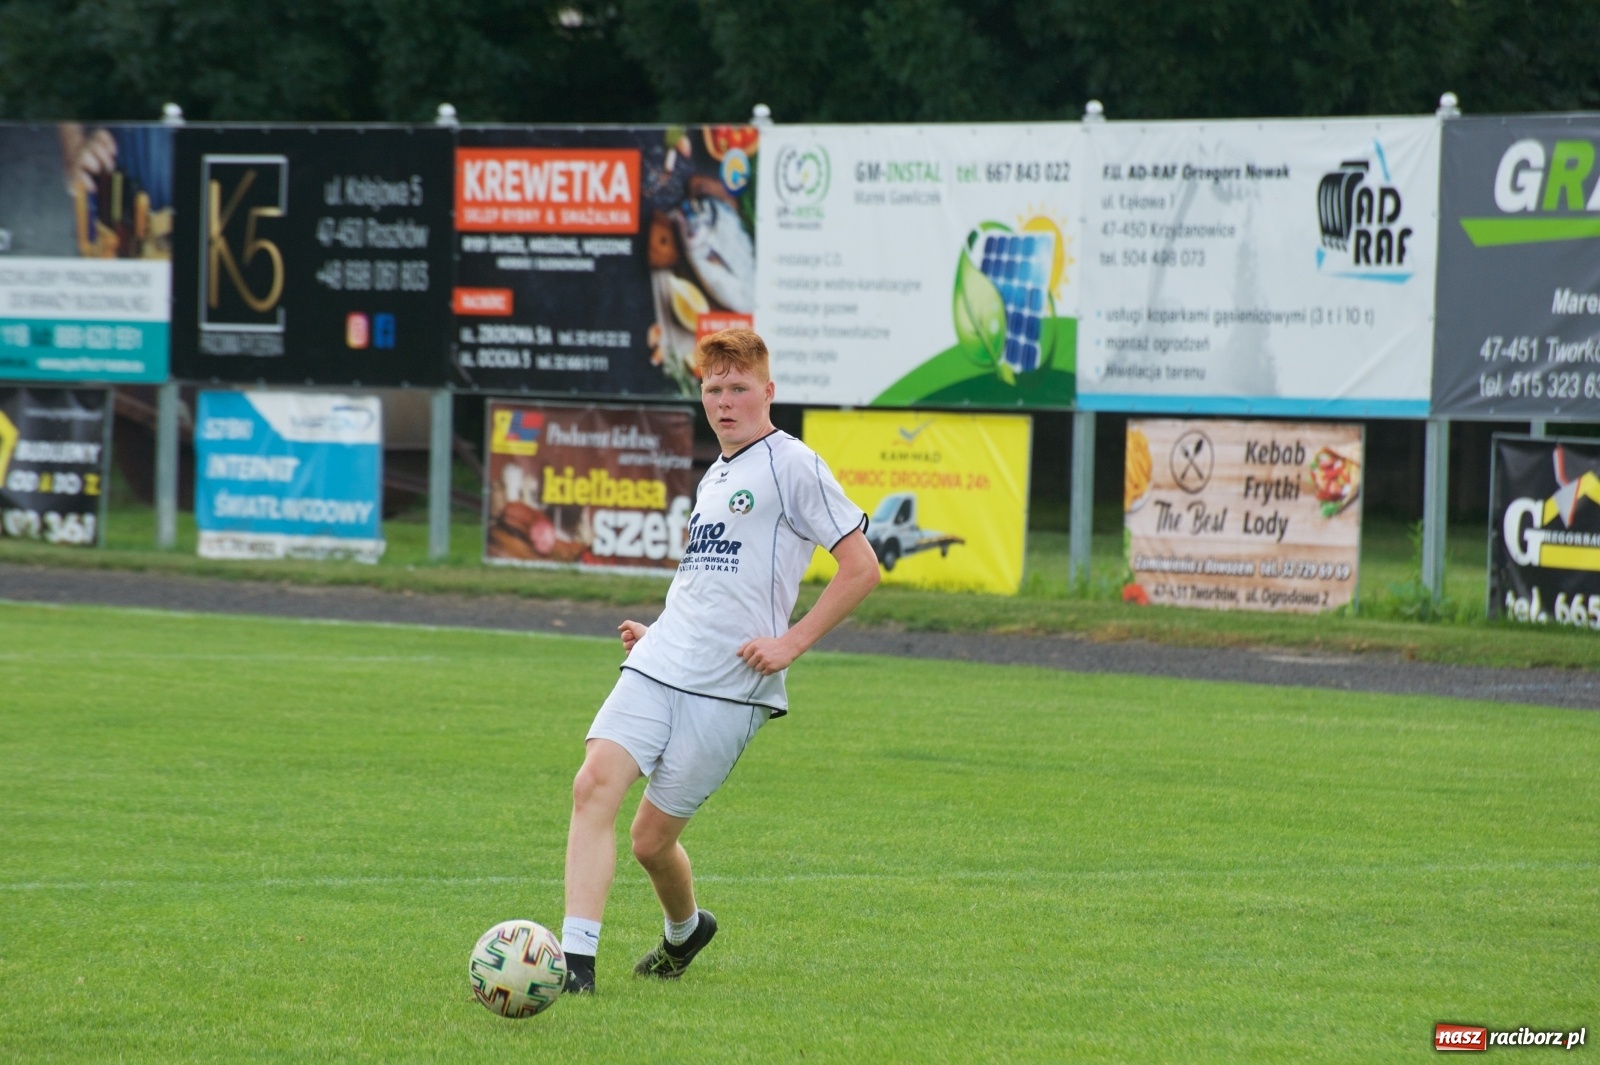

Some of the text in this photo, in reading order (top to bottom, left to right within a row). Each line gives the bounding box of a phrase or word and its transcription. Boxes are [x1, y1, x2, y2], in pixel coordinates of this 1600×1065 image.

[463, 160, 632, 204] KREWETKA
[855, 160, 1070, 183] GM-INSTAL tel. 667 843 022
[1128, 165, 1177, 180] AD-RAF
[1182, 164, 1241, 185] Grzegorz
[1245, 163, 1290, 180] Nowak
[410, 175, 423, 206] 5
[1356, 186, 1401, 226] AD
[1101, 221, 1147, 238] 47-450
[1100, 249, 1117, 267] tel.
[1122, 250, 1147, 267] 504
[1180, 250, 1207, 267] 073
[1354, 228, 1413, 265] RAF
[1106, 307, 1144, 326] usługi
[1147, 307, 1210, 326] koparkami
[1480, 337, 1538, 362] 47-451
[1479, 374, 1503, 398] tel.
[1508, 373, 1543, 398] 515
[1547, 372, 1580, 398] 323
[1244, 440, 1305, 466] Kebab
[542, 466, 667, 510] kiełbasa
[838, 469, 886, 488] POMOC
[890, 471, 961, 490] DROGOWA
[1244, 474, 1301, 506] Frytki
[1154, 499, 1227, 535] The Best
[1243, 510, 1289, 543] Lody
[705, 564, 738, 574] DUKAT)
[1260, 558, 1278, 578] tel.
[1245, 588, 1259, 602] ul.
[1321, 593, 1329, 606] 2
[1505, 586, 1600, 631] tel. 665
